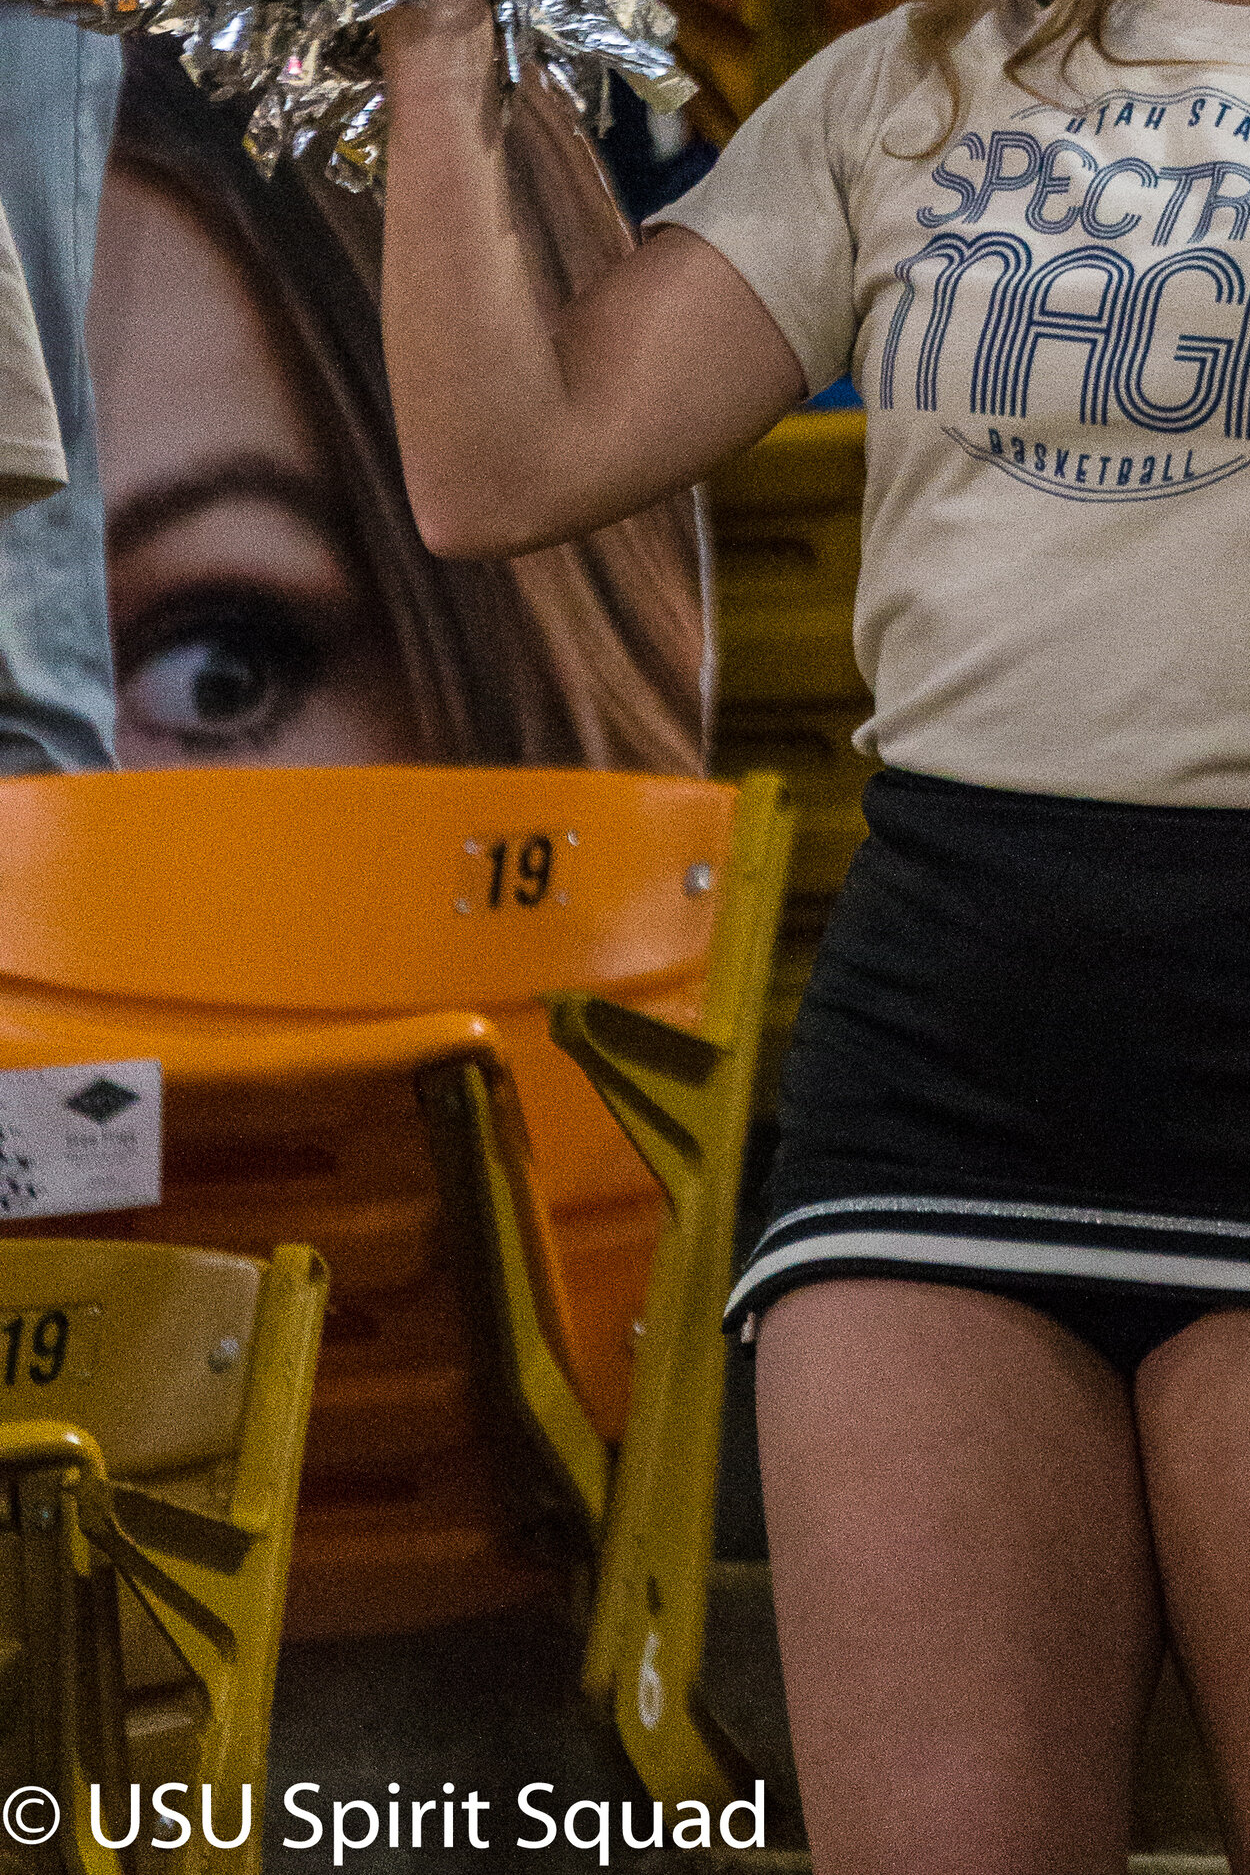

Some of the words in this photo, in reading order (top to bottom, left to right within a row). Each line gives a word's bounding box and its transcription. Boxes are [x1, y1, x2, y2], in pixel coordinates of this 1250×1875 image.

[1065, 100, 1167, 135] UTAH
[485, 833, 555, 911] 19
[0, 1309, 70, 1387] 19
